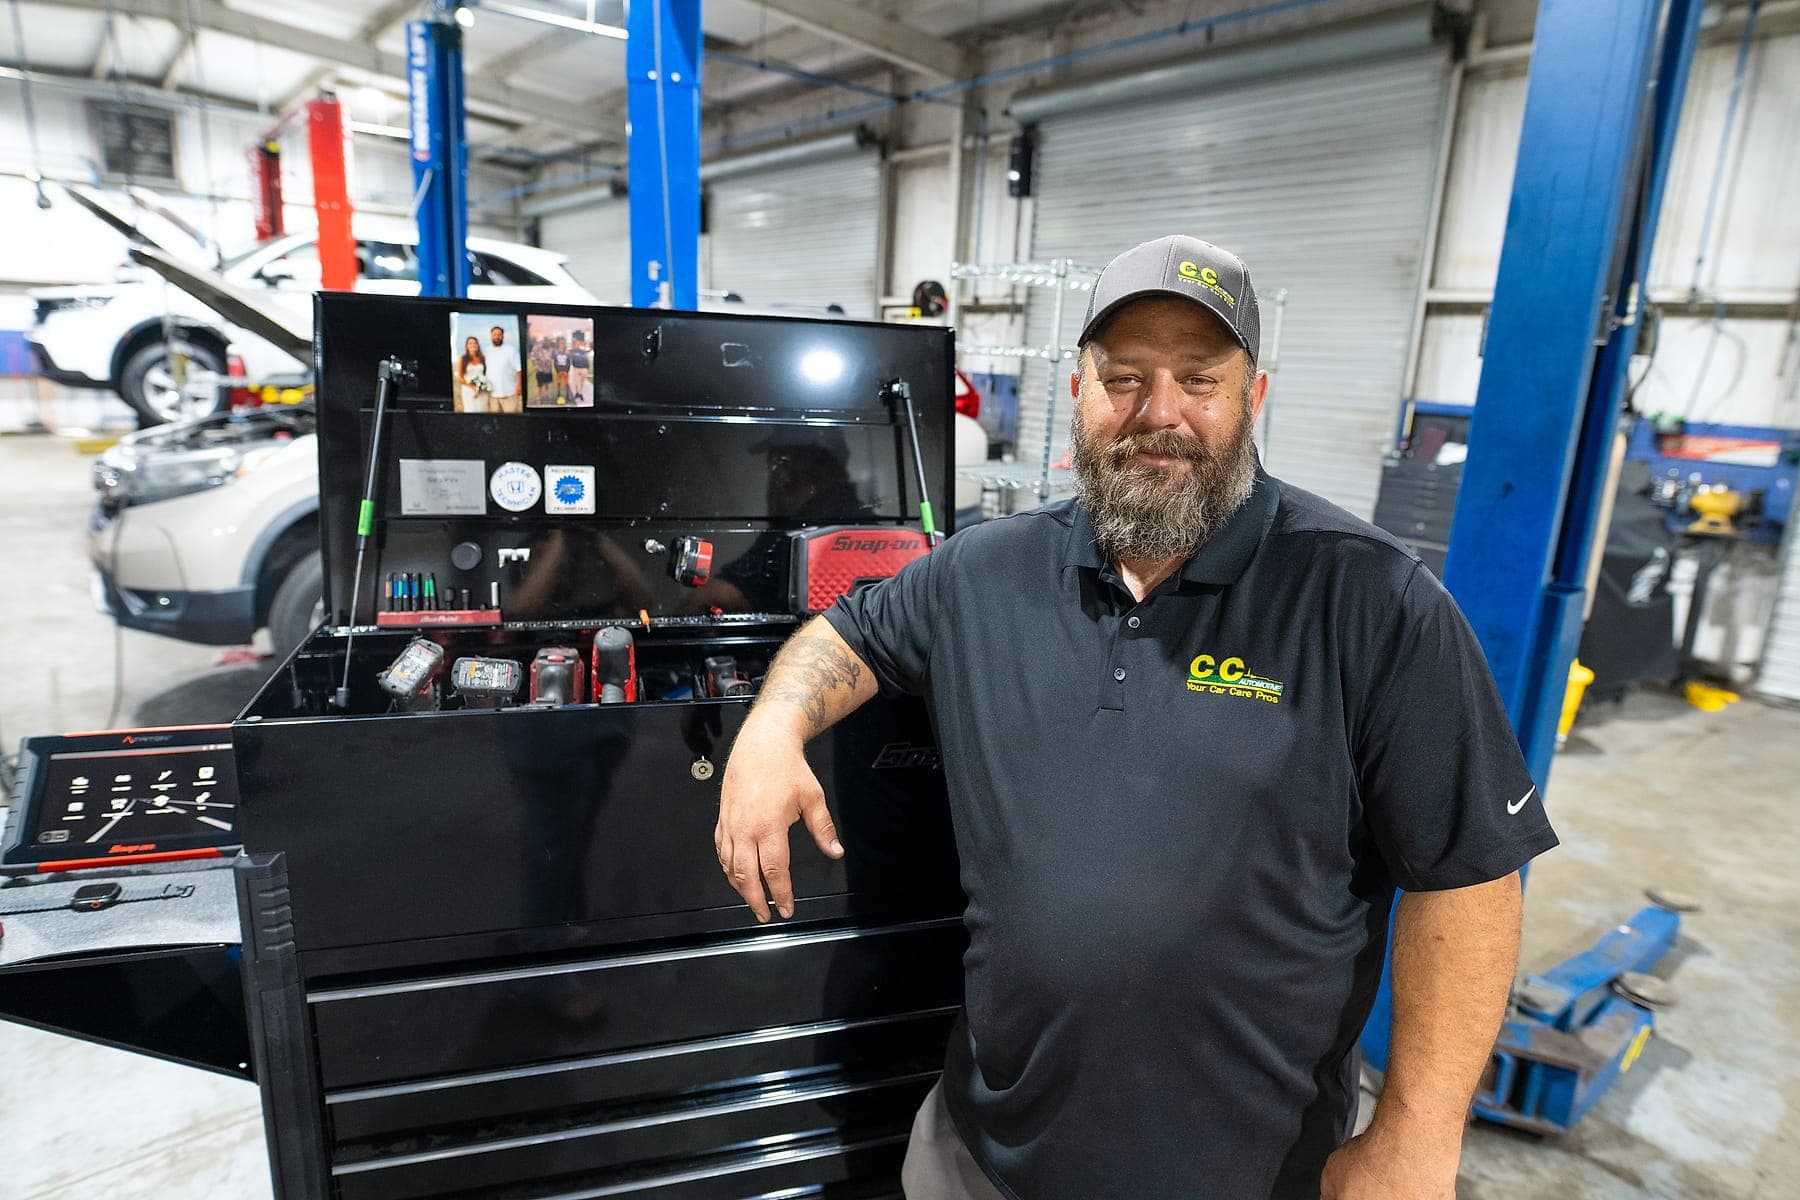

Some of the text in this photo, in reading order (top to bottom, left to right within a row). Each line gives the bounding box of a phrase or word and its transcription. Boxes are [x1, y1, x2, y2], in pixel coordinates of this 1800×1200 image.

[498, 466, 531, 479] MASTER
[831, 535, 920, 554] Snap-on
[1190, 654, 1245, 682] CC
[1186, 682, 1279, 704] Your Car Care Pros
[1239, 677, 1283, 692] AUTOMOTIVE
